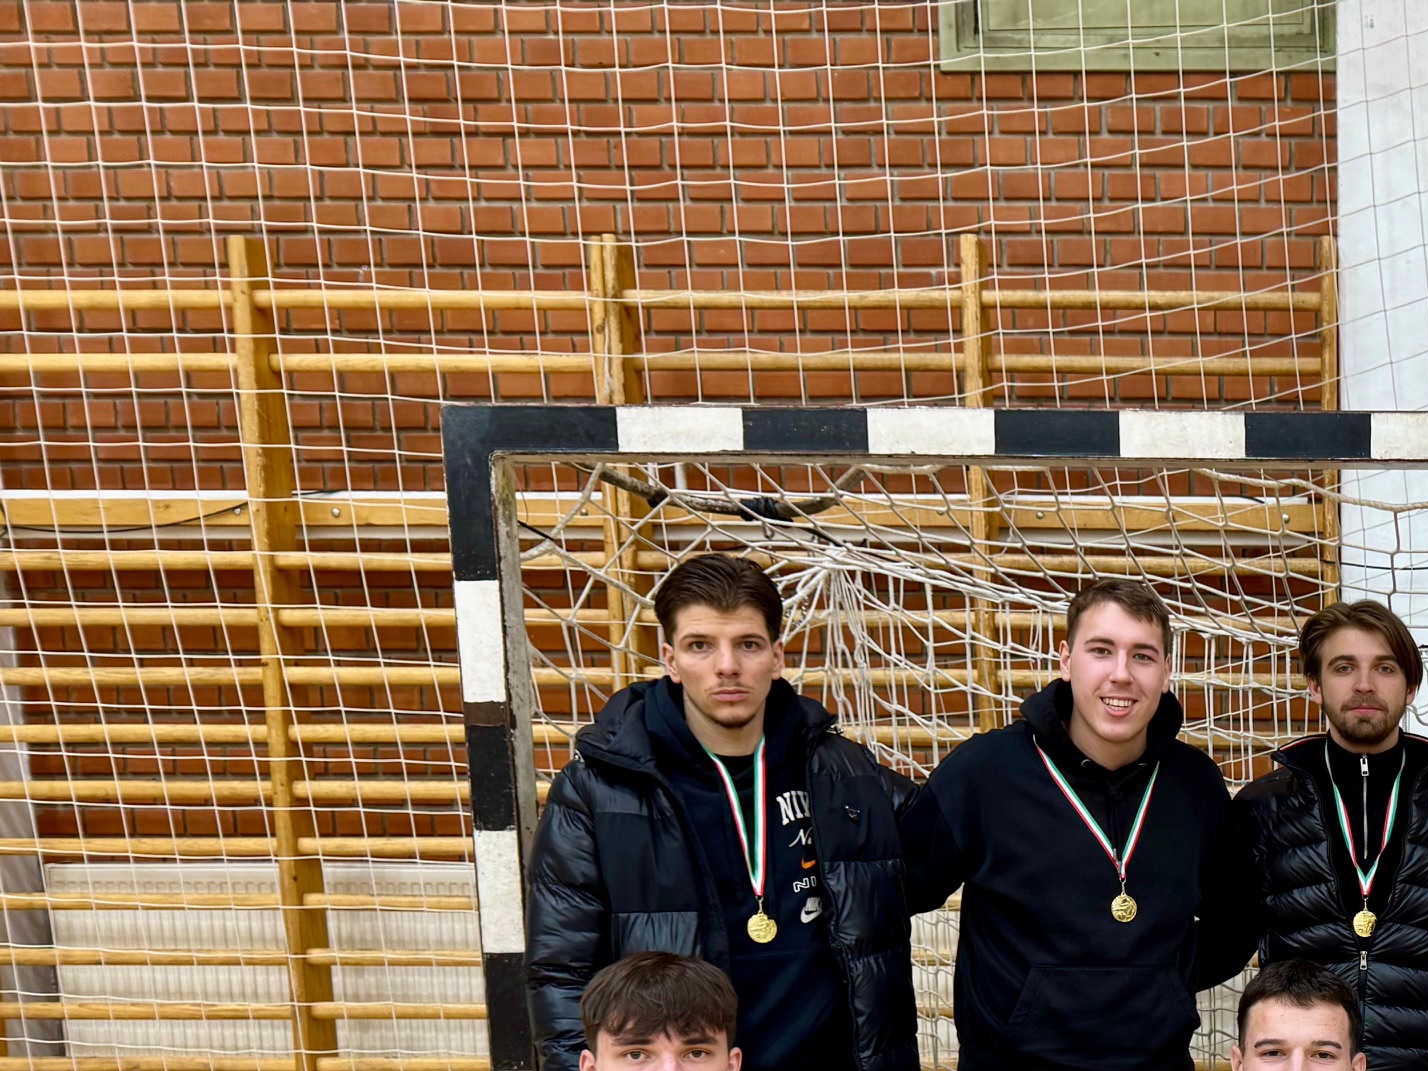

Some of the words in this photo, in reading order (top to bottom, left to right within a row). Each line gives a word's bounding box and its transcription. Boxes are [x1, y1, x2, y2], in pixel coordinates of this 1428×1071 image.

[776, 790, 811, 826] NIK
[788, 826, 812, 847] Ni
[792, 875, 816, 893] NI
